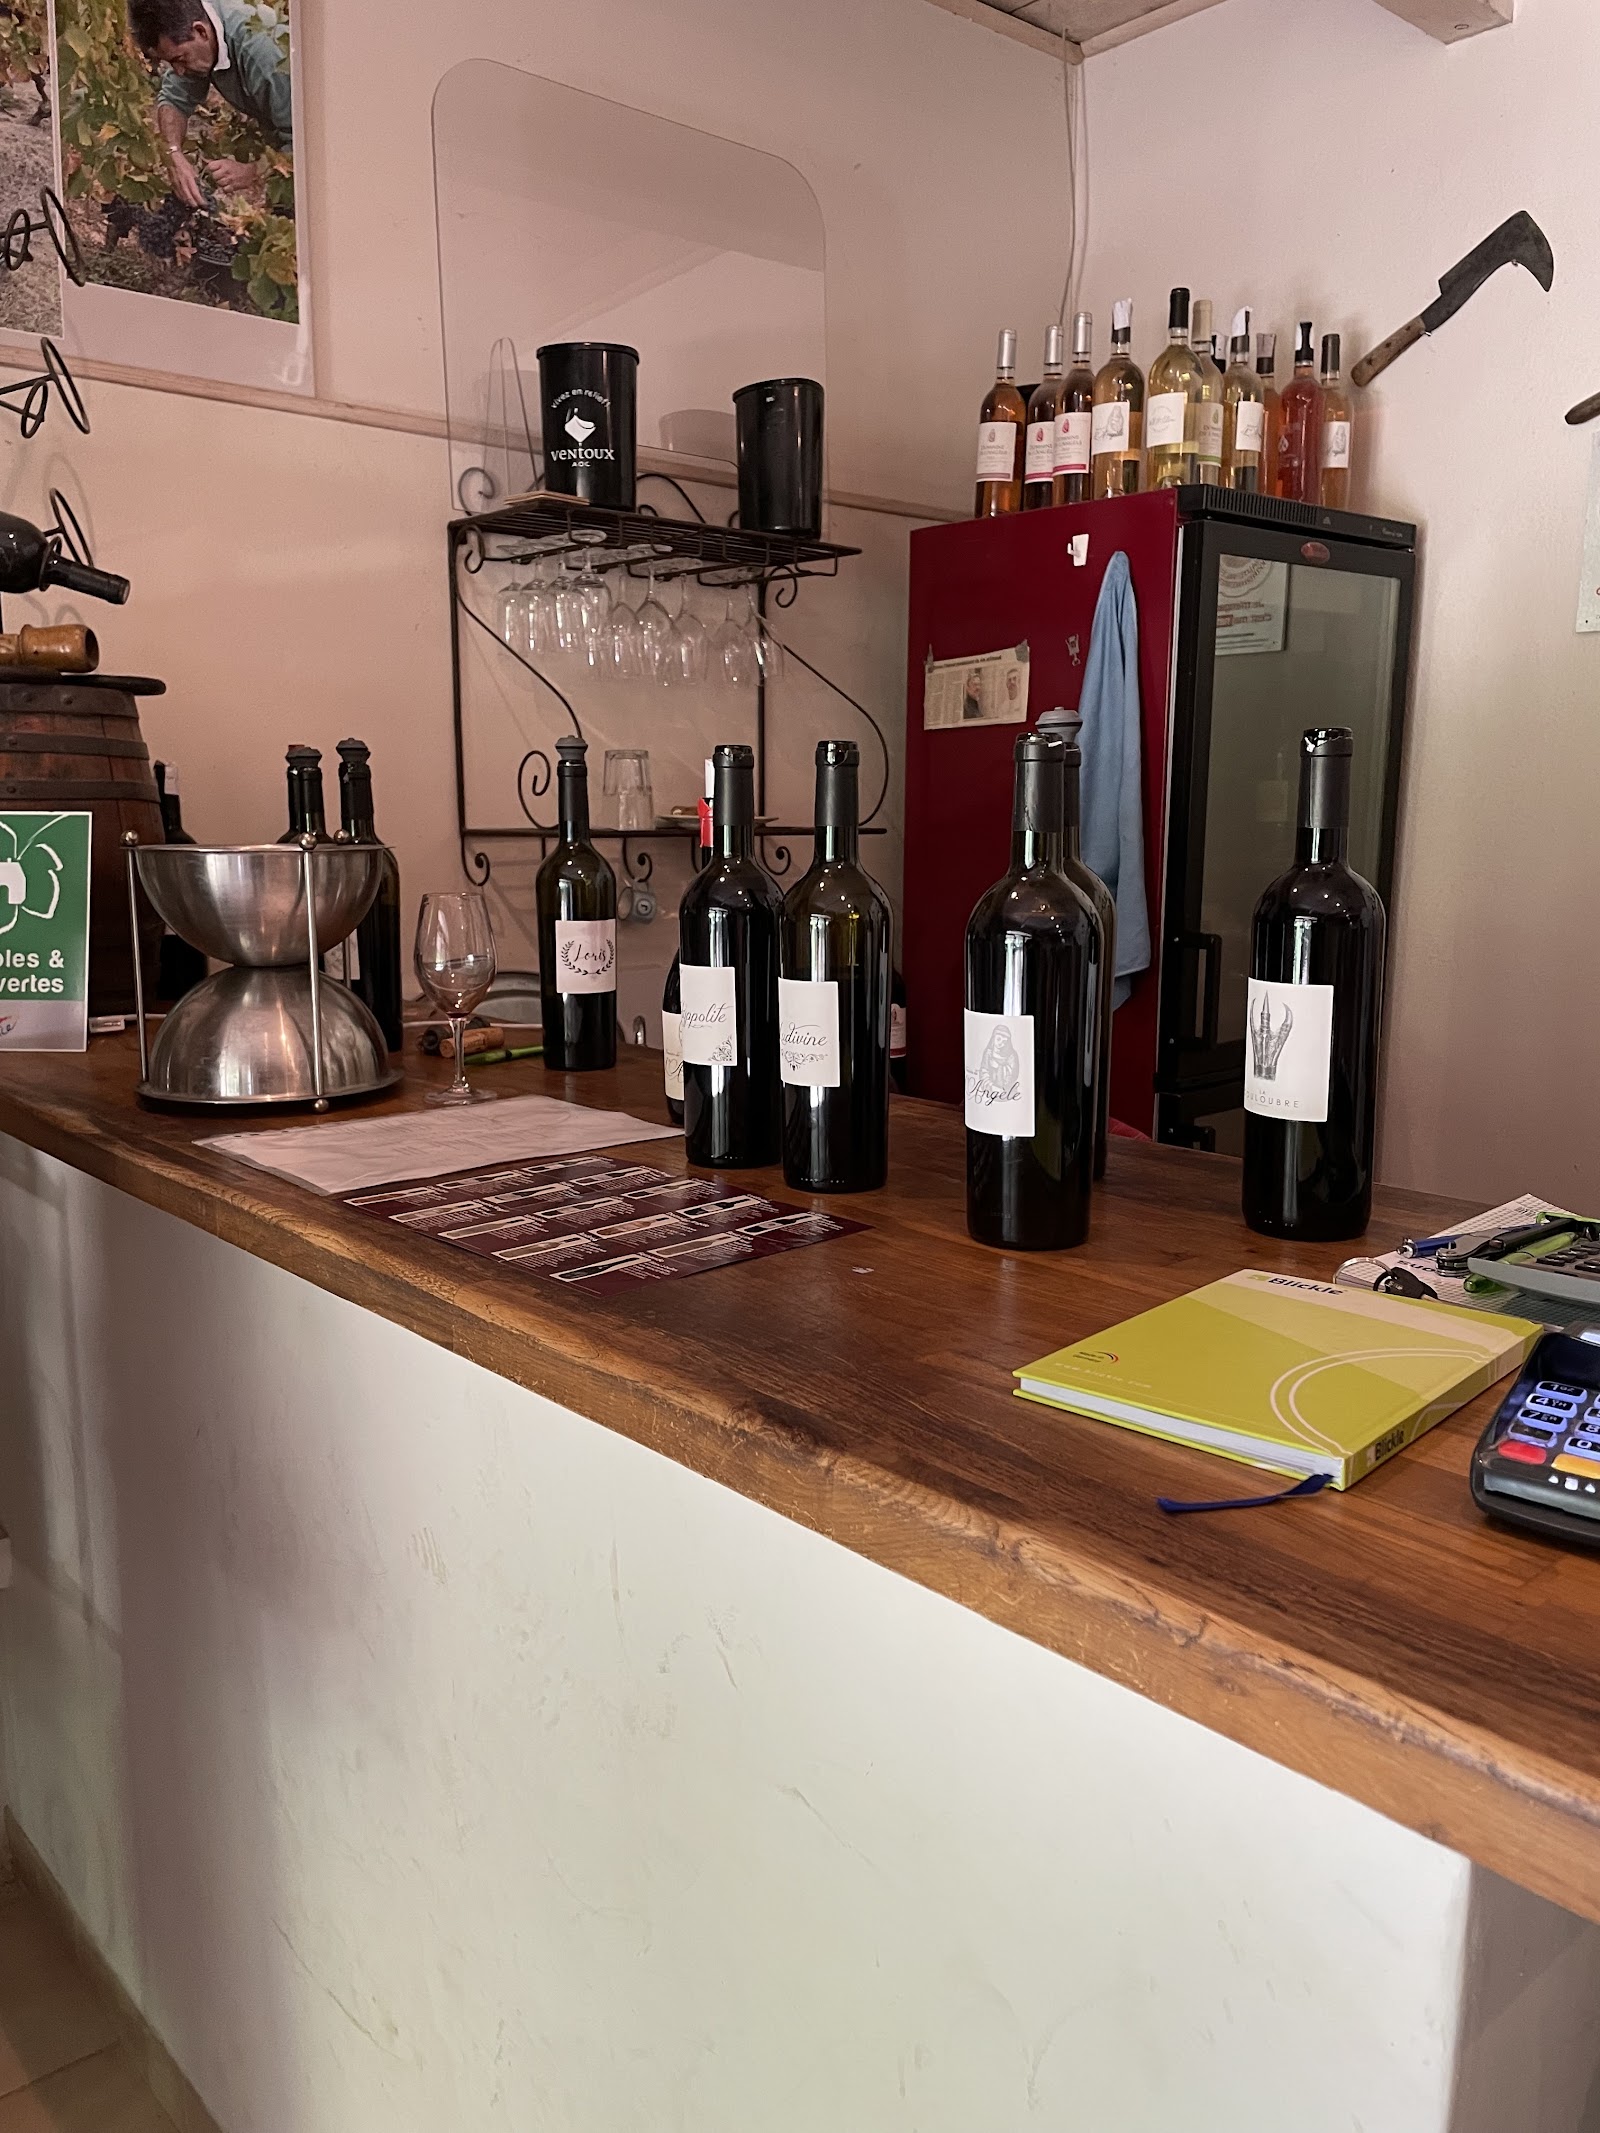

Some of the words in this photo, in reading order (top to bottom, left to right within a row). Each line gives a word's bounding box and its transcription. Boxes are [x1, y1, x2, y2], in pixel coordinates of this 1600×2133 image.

[49, 949, 65, 969] &
[1268, 1277, 1344, 1296] Blickle
[1536, 1397, 1550, 1406] 4
[1529, 1410, 1541, 1418] 7
[1375, 1430, 1405, 1461] Blickle
